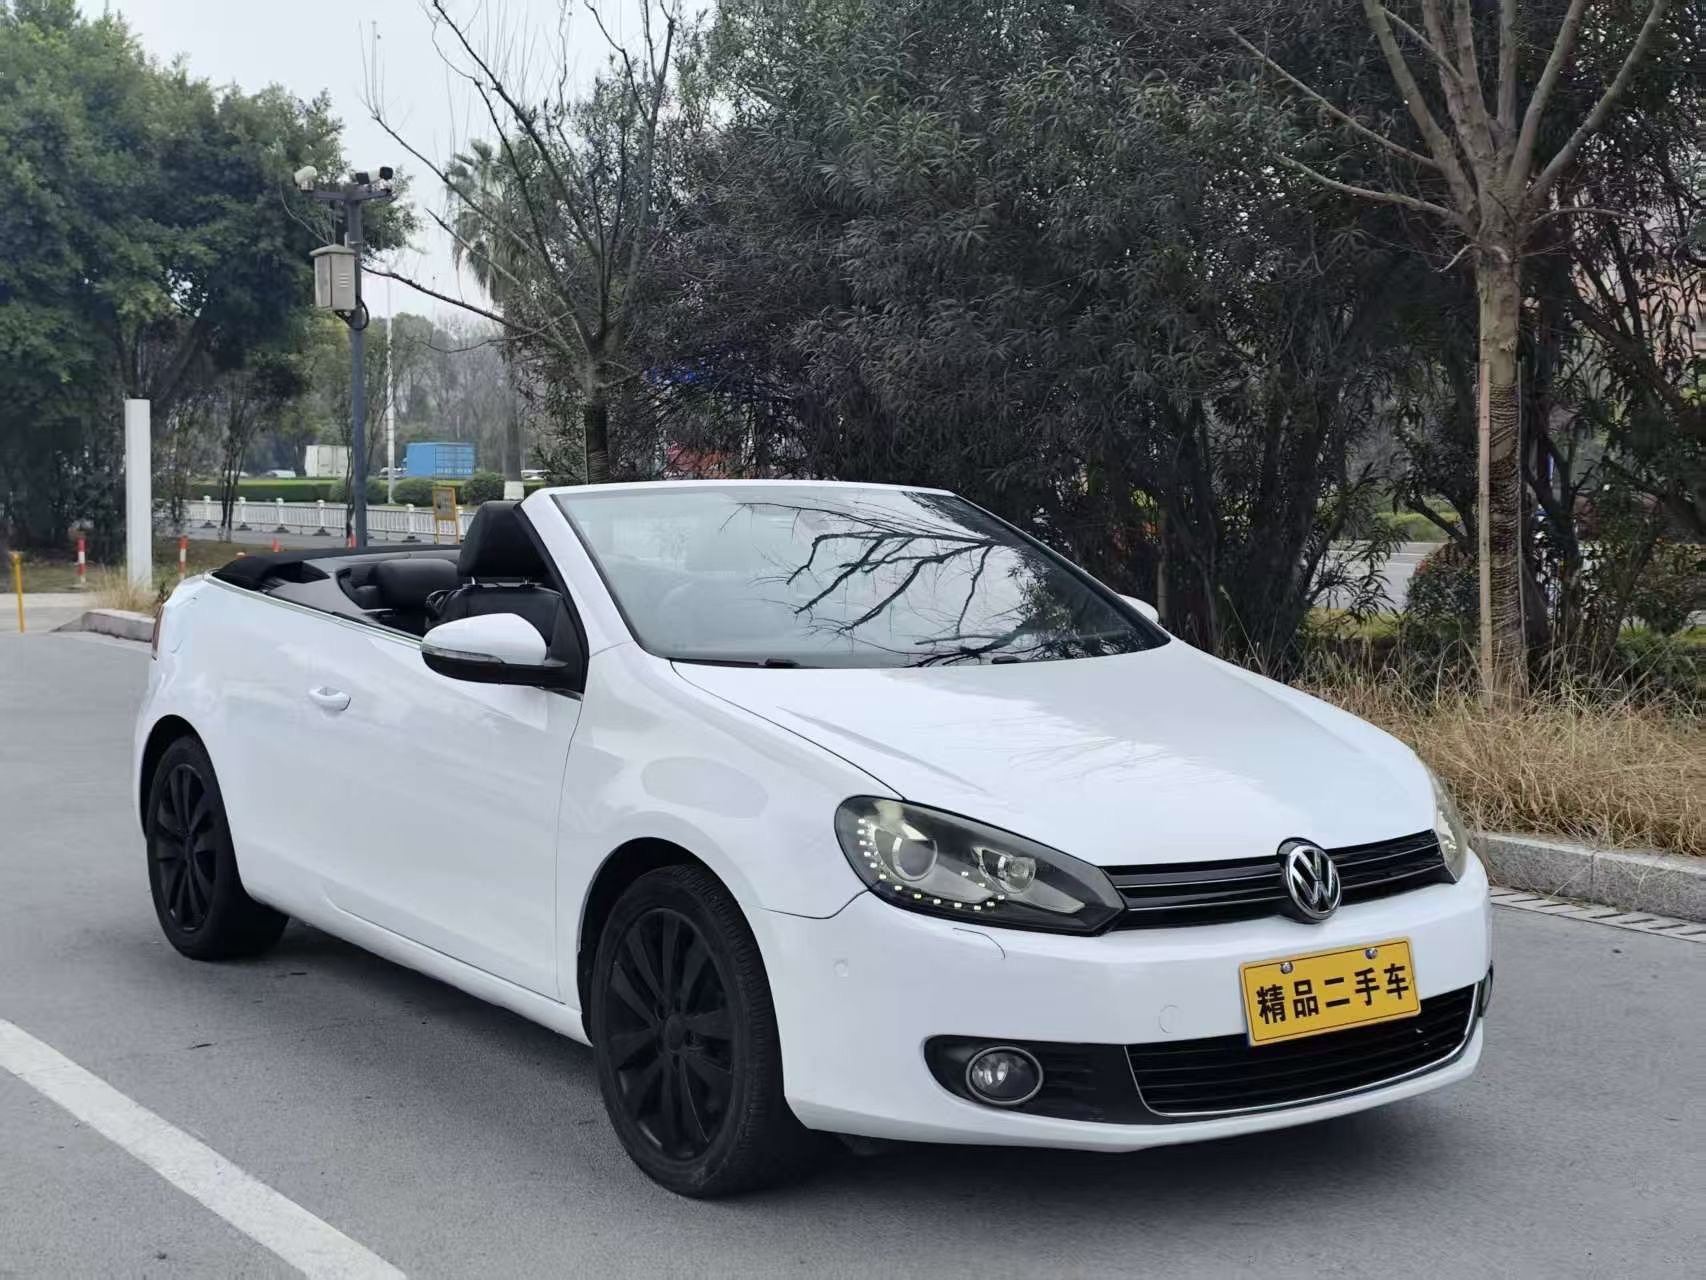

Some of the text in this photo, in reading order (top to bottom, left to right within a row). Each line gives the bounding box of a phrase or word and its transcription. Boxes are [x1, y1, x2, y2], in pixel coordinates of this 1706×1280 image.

[1256, 963, 1409, 1025] 精品二手车
